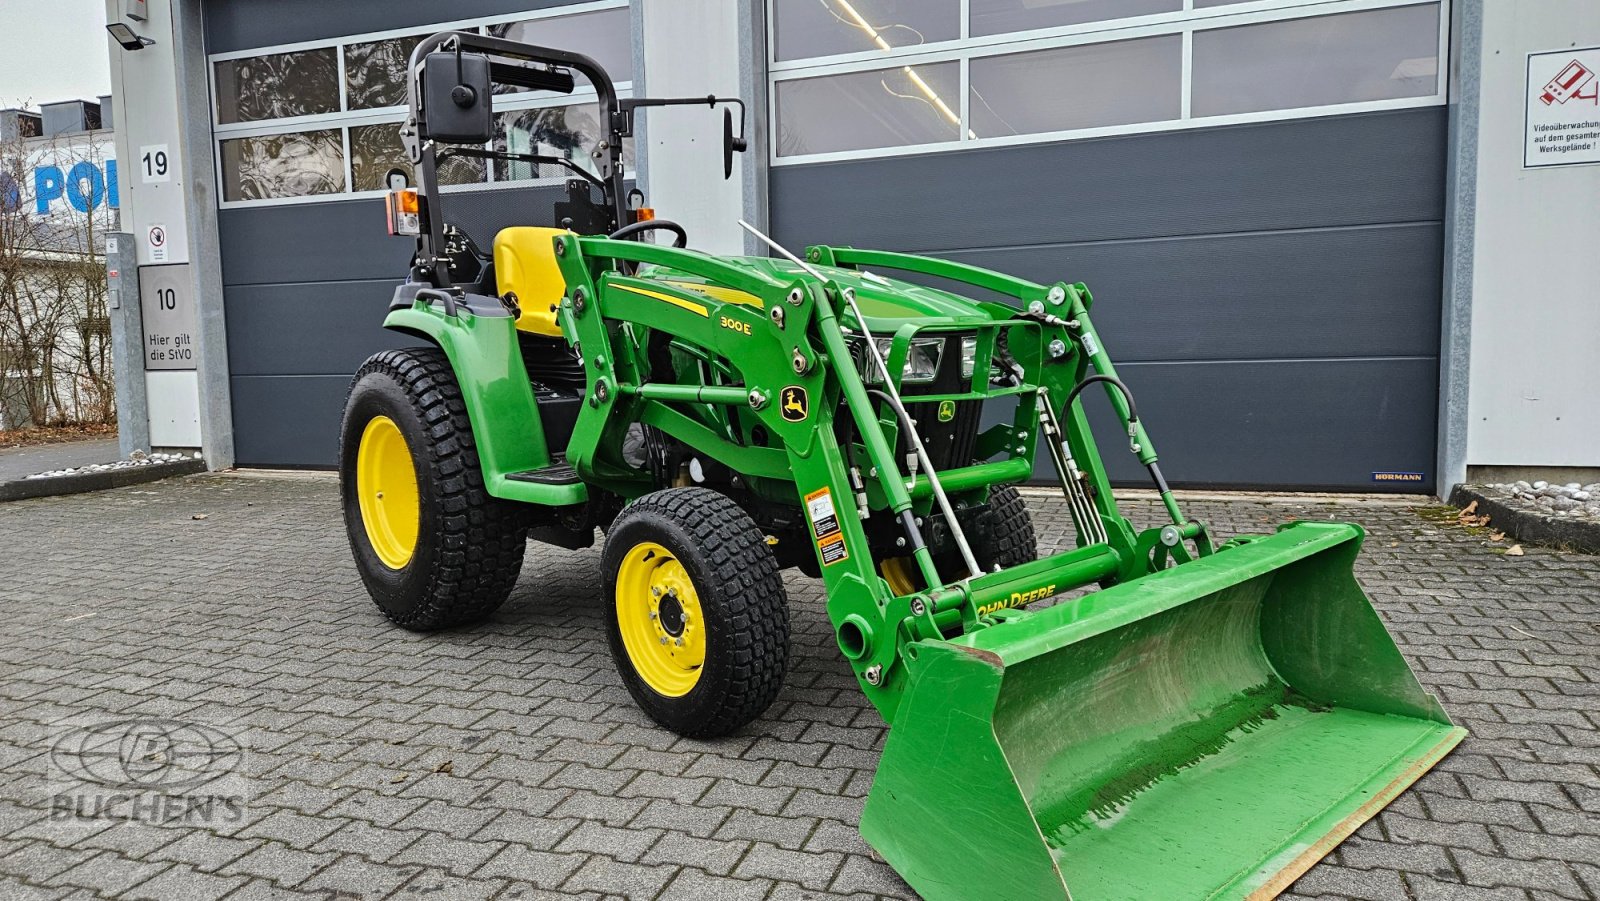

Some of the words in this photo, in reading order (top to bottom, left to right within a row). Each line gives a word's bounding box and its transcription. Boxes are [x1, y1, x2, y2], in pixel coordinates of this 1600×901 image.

[1534, 134, 1546, 143] auf
[1548, 133, 1564, 142] dem
[1539, 142, 1591, 153] Werksgelände
[142, 151, 168, 176] 19
[157, 288, 176, 310] 10
[149, 334, 169, 345] Hier
[174, 333, 191, 347] gilt
[150, 349, 165, 360] die
[169, 348, 191, 360] StVO
[977, 599, 1008, 618] OHN
[1010, 584, 1056, 608] DEERE
